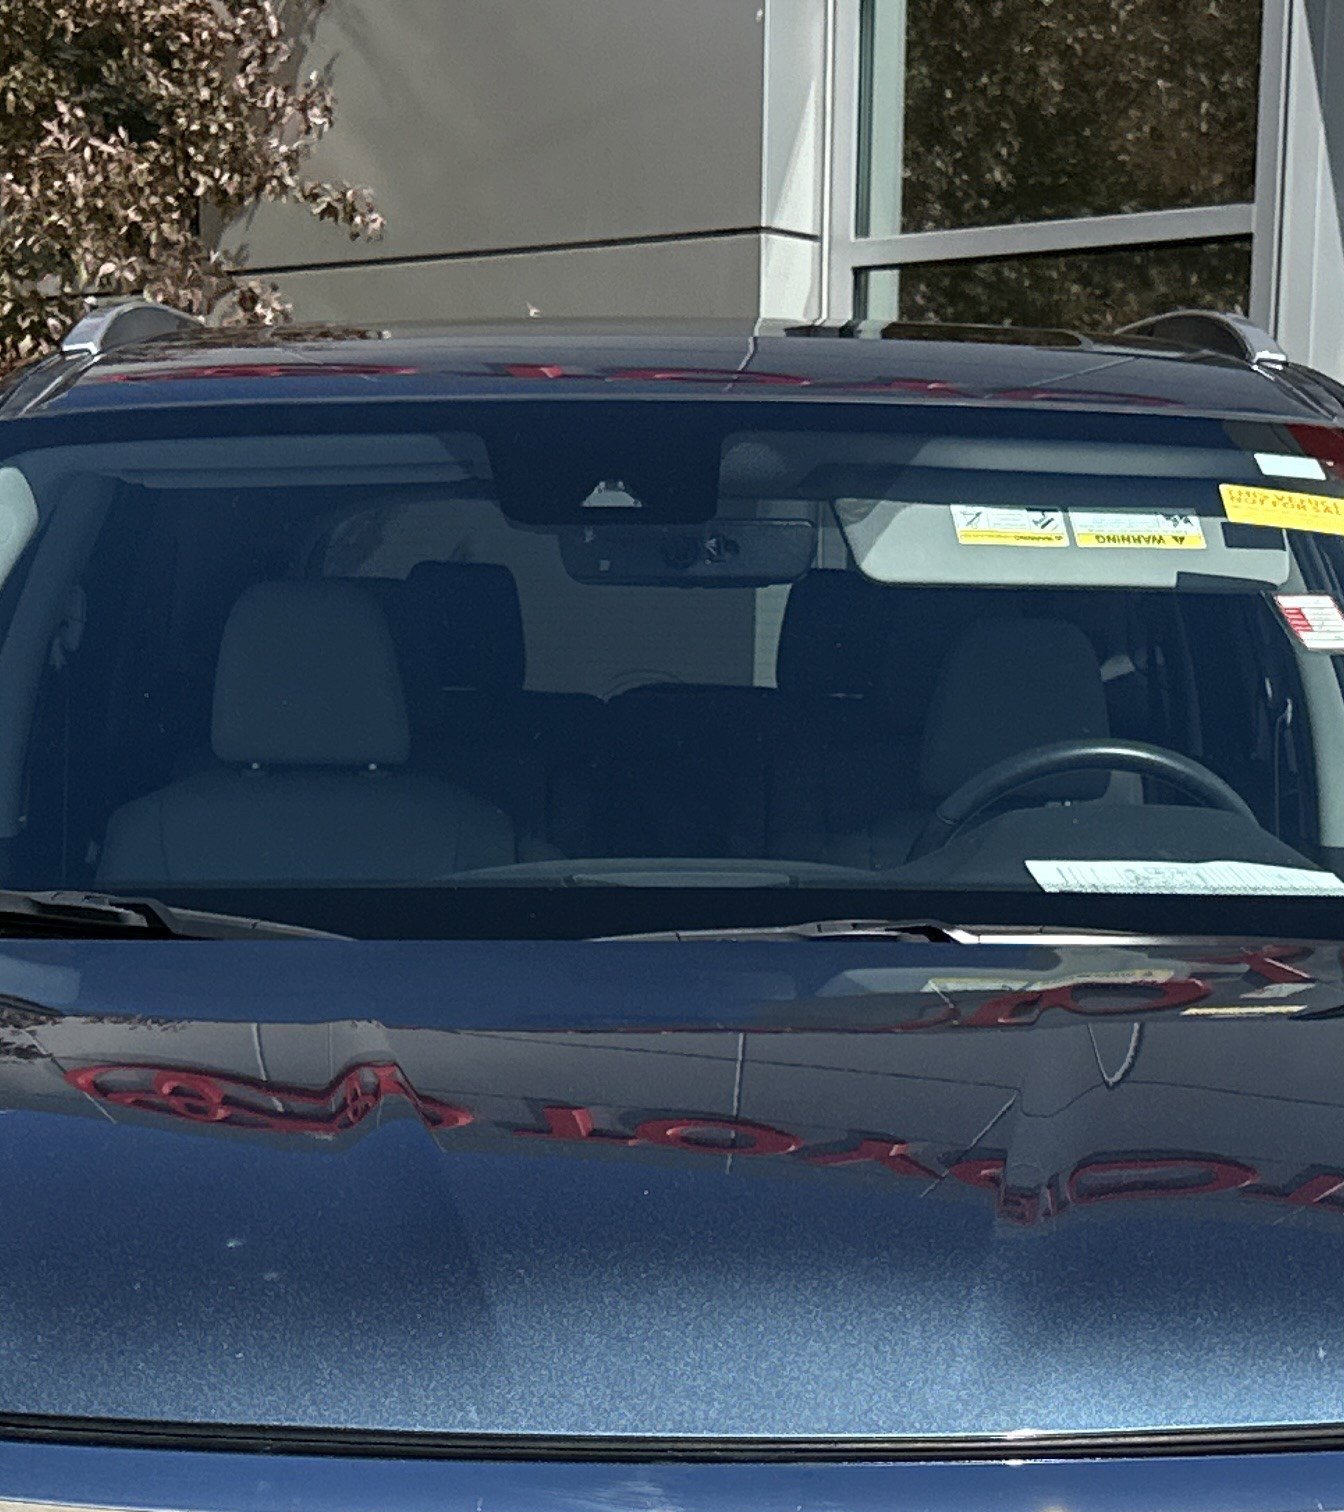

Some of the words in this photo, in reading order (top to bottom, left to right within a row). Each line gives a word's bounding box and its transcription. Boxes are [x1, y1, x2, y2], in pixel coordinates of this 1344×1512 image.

[1229, 495, 1265, 506] NOT
[1271, 499, 1307, 512] FOR
[1095, 534, 1167, 545] WARNING
